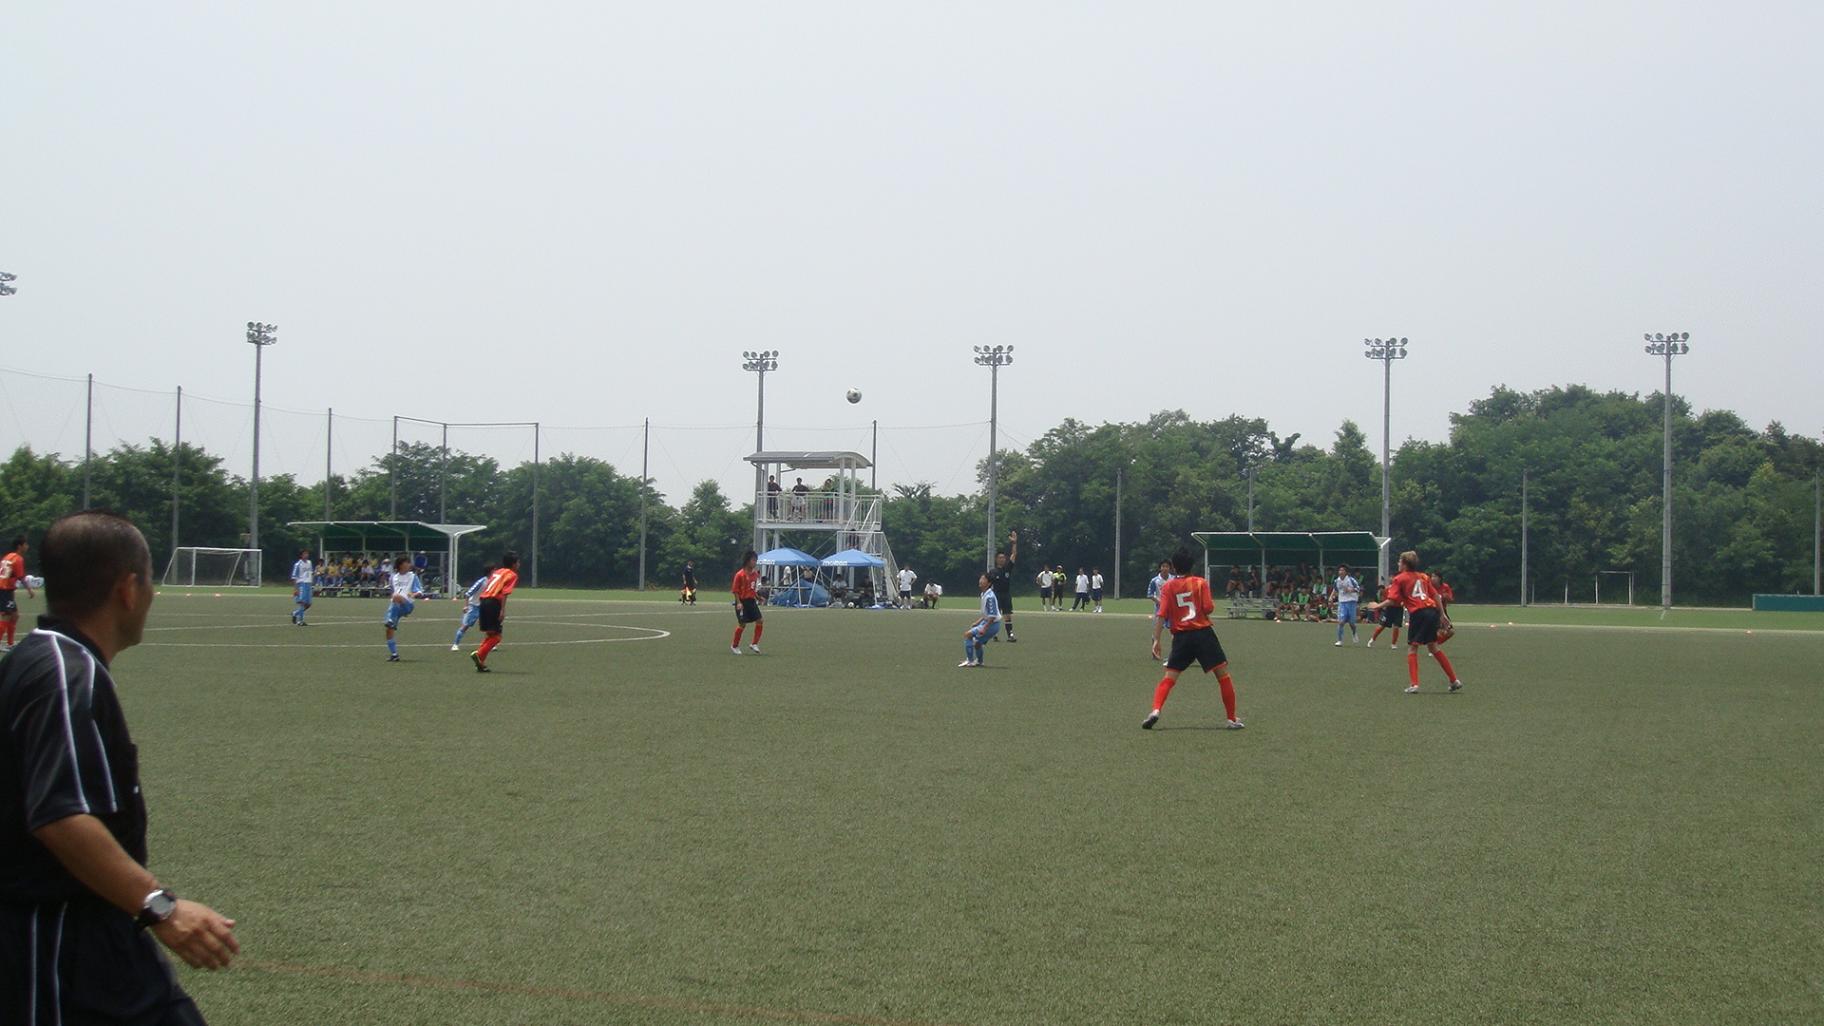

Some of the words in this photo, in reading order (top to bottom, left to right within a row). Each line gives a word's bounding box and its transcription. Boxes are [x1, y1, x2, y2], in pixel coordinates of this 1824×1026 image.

[486, 573, 501, 592] 7
[1411, 579, 1426, 600] 4
[1175, 591, 1196, 622] 5
